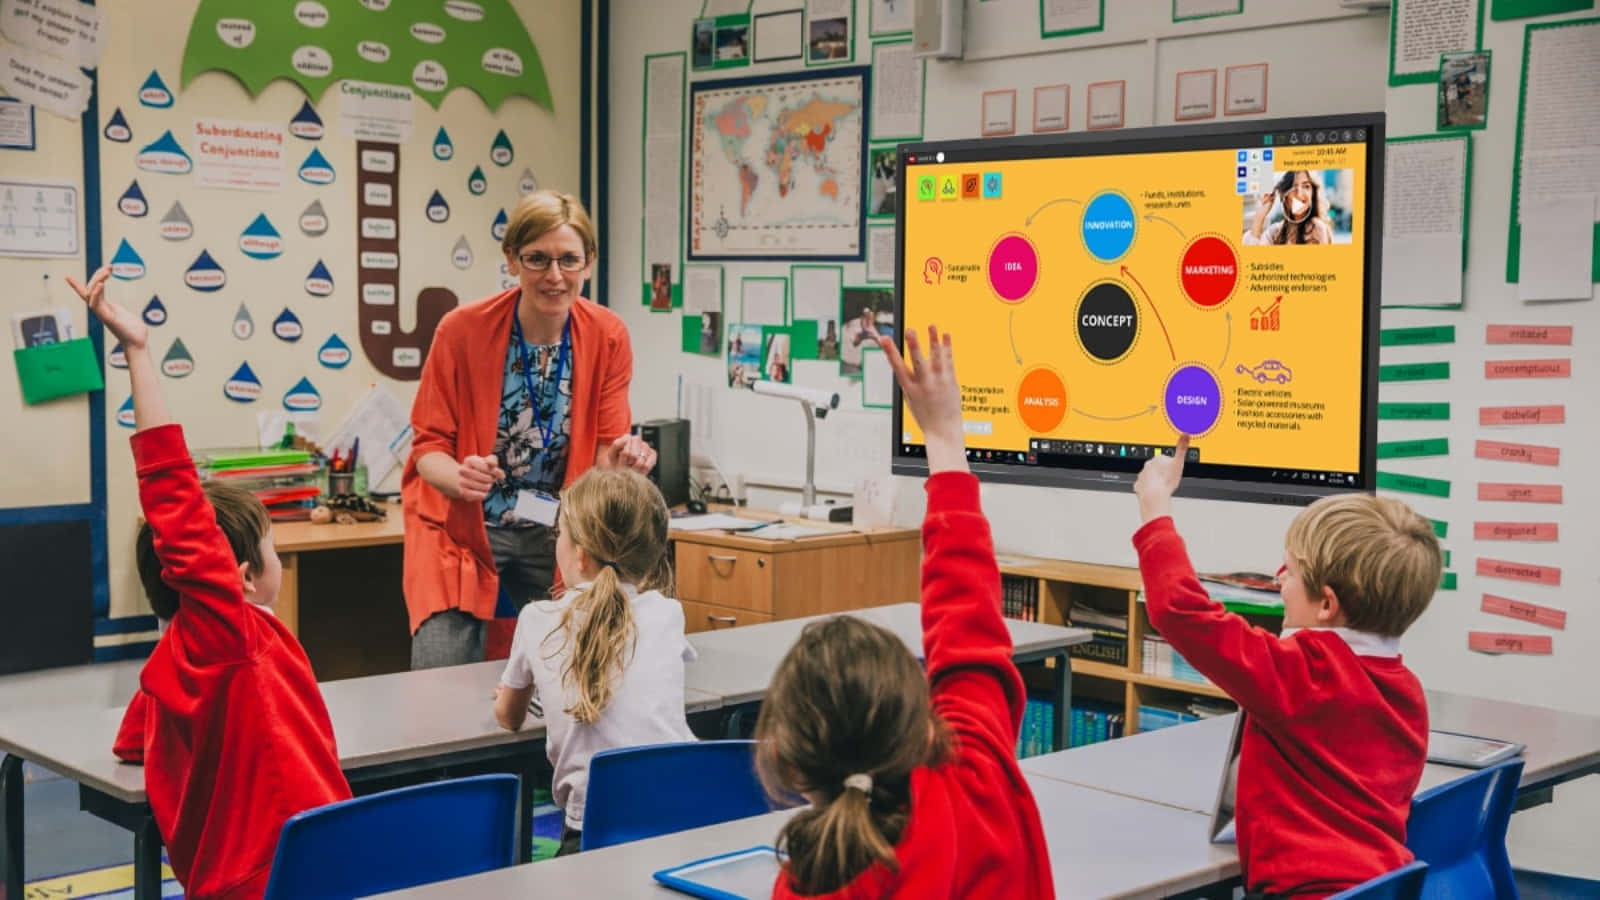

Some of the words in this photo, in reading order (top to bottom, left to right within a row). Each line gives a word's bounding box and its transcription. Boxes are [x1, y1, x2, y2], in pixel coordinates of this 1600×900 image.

[14, 8, 29, 17] got
[32, 14, 44, 24] my
[46, 20, 76, 34] answer
[42, 5, 73, 19] explain
[74, 15, 91, 28] how
[220, 22, 252, 31] instead
[37, 28, 70, 45] friend?
[9, 58, 31, 74] Does
[33, 70, 45, 81] my
[48, 74, 78, 90] answer
[14, 76, 36, 90] make
[39, 86, 69, 100] sense?
[341, 82, 412, 100] Conjunctions
[196, 122, 283, 144] Subordinating
[200, 142, 280, 158] Conjunctions
[1144, 201, 1172, 210] research
[1172, 200, 1191, 209] units
[1085, 220, 1132, 230] INNOVATION
[243, 238, 280, 250] although
[948, 264, 981, 272] Sustainable
[1004, 262, 1022, 271] IDEA
[1185, 265, 1234, 275] MARKETING
[1250, 262, 1284, 270] Subsidies
[948, 274, 968, 282] energy
[1250, 272, 1289, 282] Authorized
[1290, 272, 1336, 282] technologies
[1250, 283, 1290, 293] Advertising
[1290, 284, 1328, 292] endorsers
[1082, 314, 1133, 328] CONCEPT
[1510, 329, 1549, 340] irritated
[1494, 364, 1560, 376] contemptuous
[1237, 388, 1263, 397] Electric
[1264, 388, 1292, 398] vehicles
[1024, 396, 1060, 406] ANALYSIS
[1176, 396, 1208, 405] DESIGN
[1237, 399, 1289, 409] Solar-powered
[1290, 402, 1325, 410] museums
[962, 405, 990, 413] Consumer
[990, 406, 1010, 415] goods
[1236, 410, 1264, 418] Fashion
[1265, 412, 1306, 420] accessories
[1307, 412, 1323, 420] with
[1502, 409, 1541, 422] disbelief
[1237, 420, 1266, 430] recycled
[1267, 421, 1301, 431] materials
[1500, 447, 1532, 461] cranky
[1507, 489, 1532, 500] upset
[1494, 526, 1537, 538] disgusted
[1494, 566, 1541, 578] distracted
[1072, 644, 1120, 659] ENGLISH
